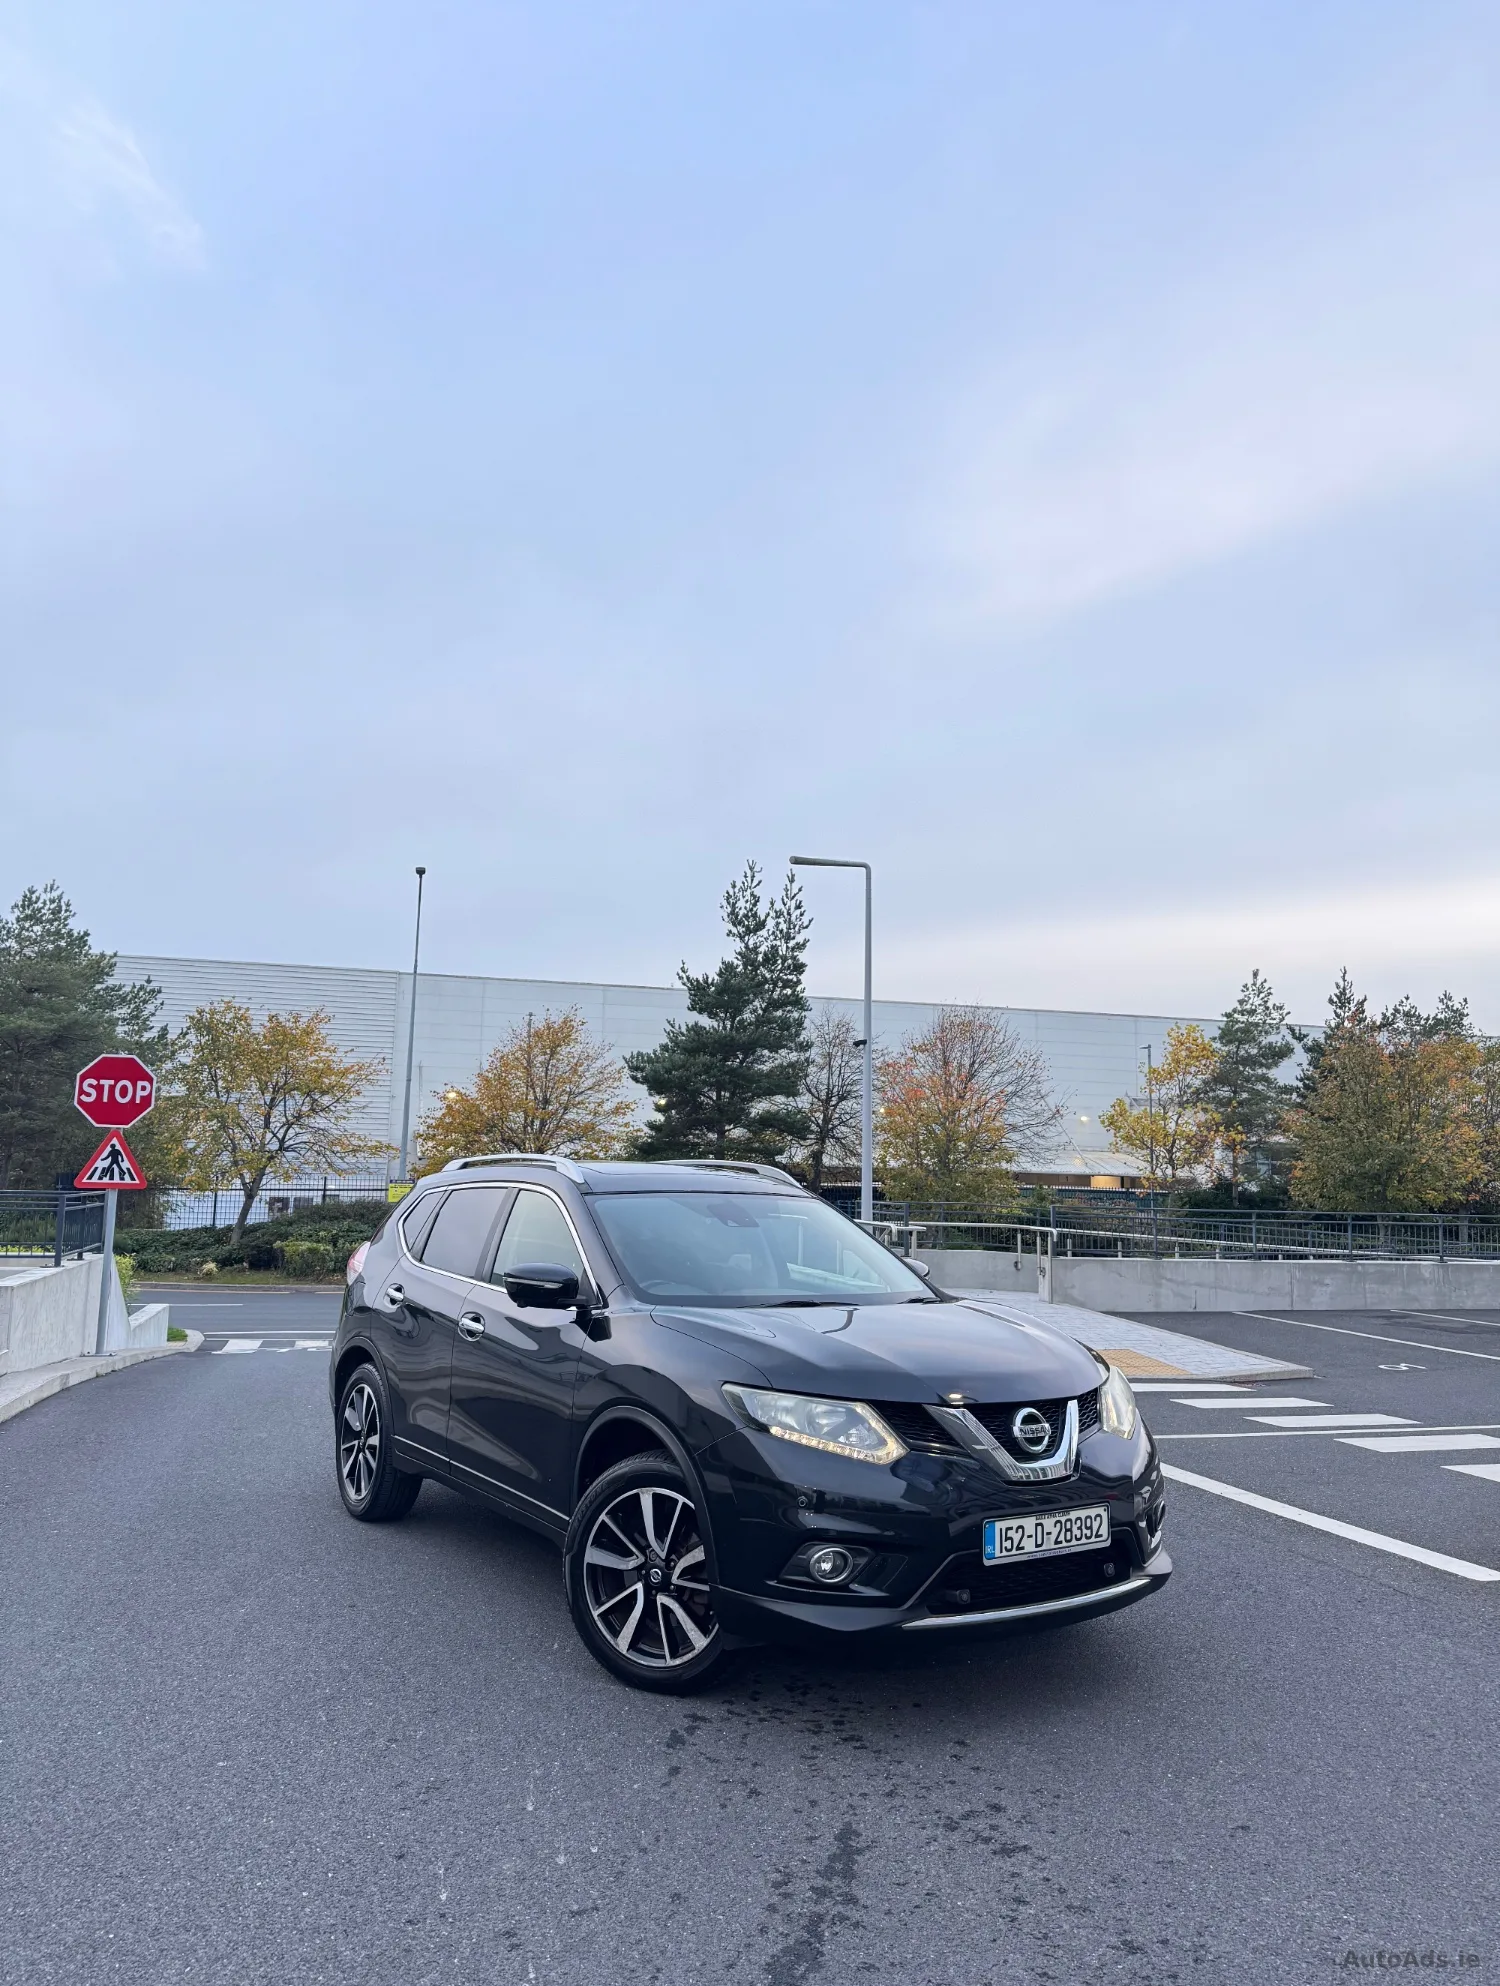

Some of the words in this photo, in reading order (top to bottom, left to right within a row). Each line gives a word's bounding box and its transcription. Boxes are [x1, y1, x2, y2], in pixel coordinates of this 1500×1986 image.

[80, 1078, 151, 1104] STOP
[1019, 1424, 1050, 1437] NISSAN
[1000, 1514, 1103, 1554] 152-D-28392
[986, 1545, 996, 1553] IRL
